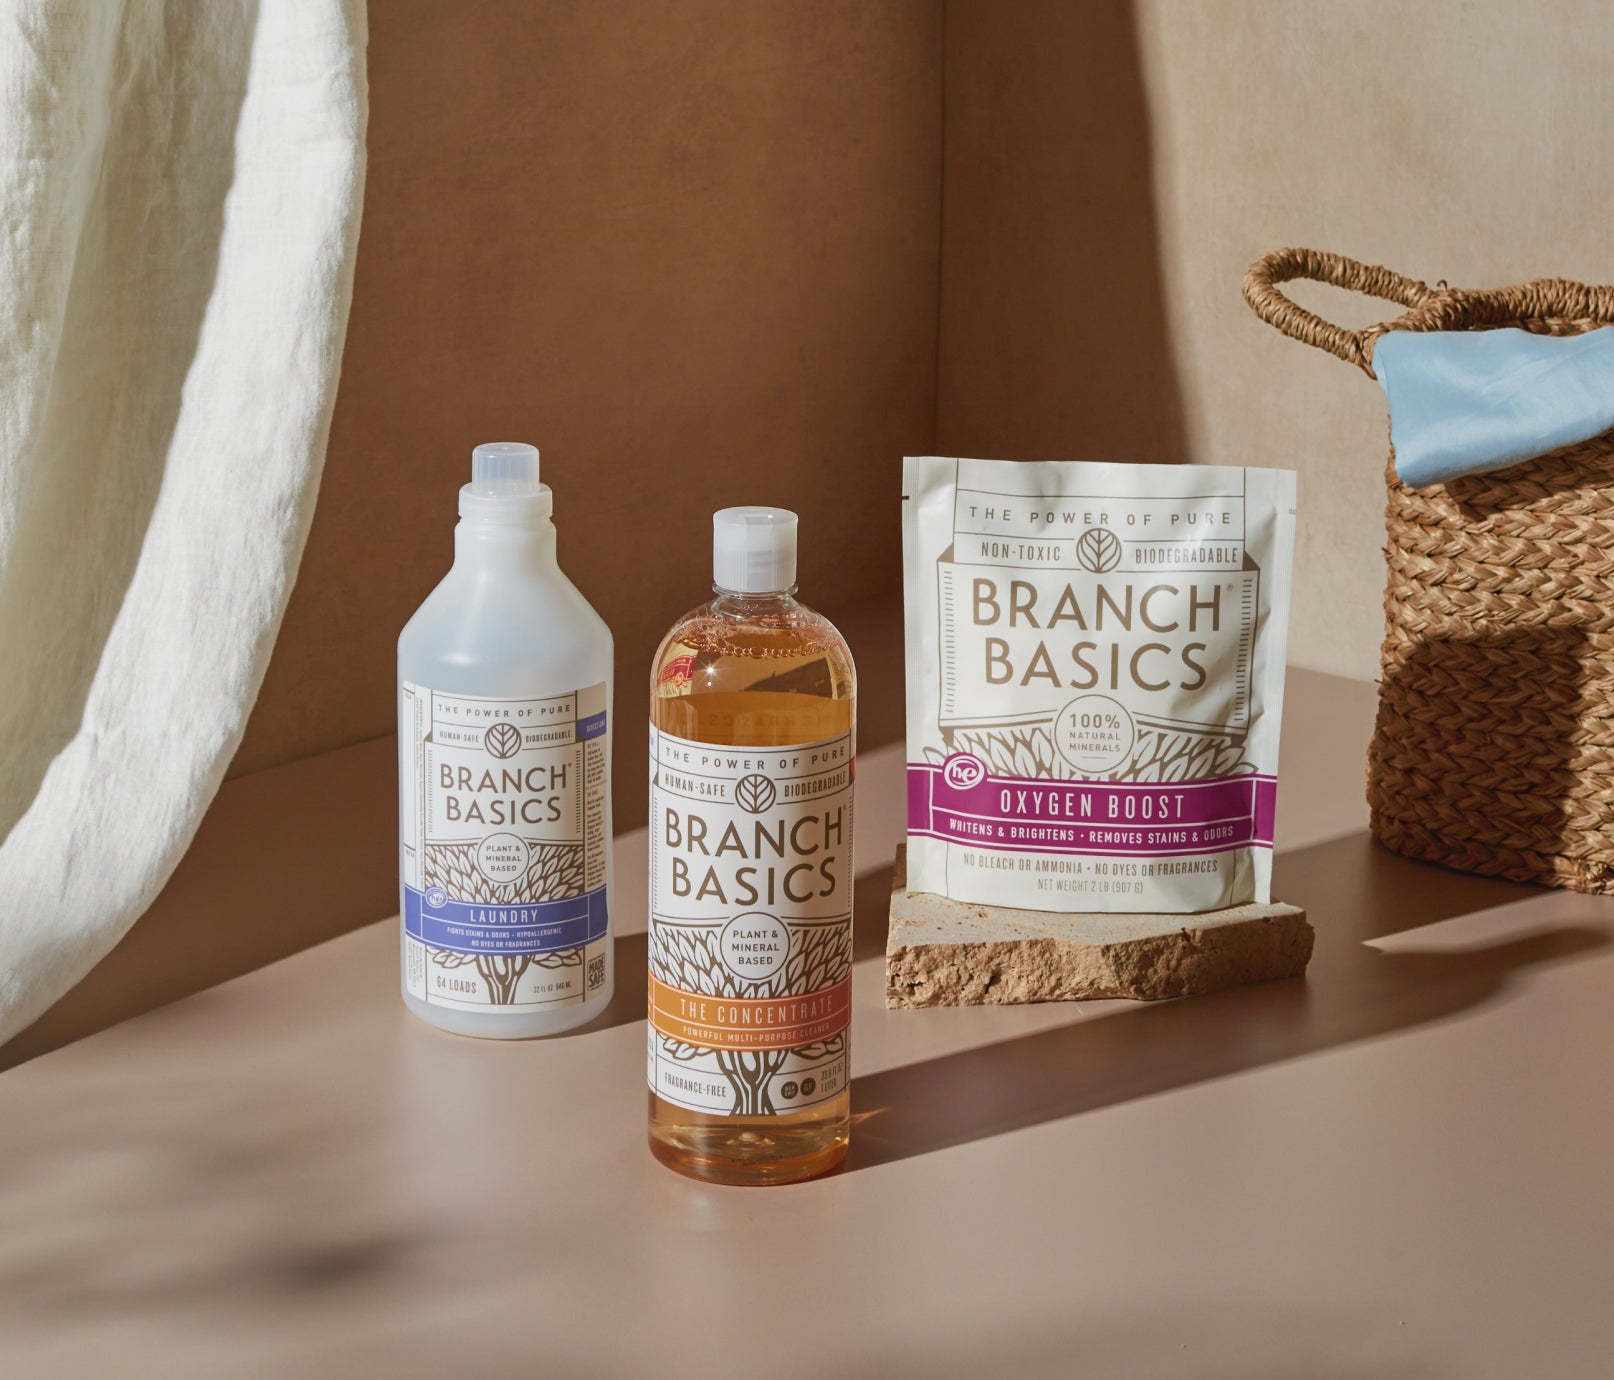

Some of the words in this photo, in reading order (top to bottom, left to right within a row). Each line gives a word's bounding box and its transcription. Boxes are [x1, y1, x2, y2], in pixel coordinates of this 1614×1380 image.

[969, 506, 1012, 522] THE
[1030, 512, 1109, 526] POWER
[1126, 514, 1152, 526] OF
[1171, 512, 1230, 526] PURE
[981, 542, 1061, 561] NON-TOXIC
[1135, 548, 1238, 564] BIODEGRADABLE
[972, 578, 1221, 632] BRANCH
[985, 637, 1207, 692] BASICS
[438, 704, 458, 714] THE
[466, 708, 510, 718] POWER
[541, 704, 571, 715] PURE
[1070, 713, 1120, 729] 100%
[440, 731, 479, 742] HUMAN-SAFE
[526, 730, 572, 742] BIODEGRADABLE
[1069, 732, 1121, 740] NATURAL
[1069, 743, 1121, 752] MINERALS
[666, 747, 689, 763] THE
[702, 756, 764, 770] POWER
[780, 758, 800, 768] OF
[812, 746, 844, 764] PURE
[440, 763, 567, 793] BRANCH
[665, 773, 726, 796] HUMAN-SAFE
[784, 770, 846, 797] BIODEGRADABLE
[446, 796, 561, 826] BASICS
[1000, 790, 1092, 817] OXYGEN
[1109, 795, 1184, 818] BOOST
[666, 807, 842, 859] BRANCH
[950, 818, 992, 836] WHITENS
[998, 827, 1005, 836] &
[1011, 828, 1074, 841] BRIGHTENS
[1089, 830, 1142, 844] REMOVES
[1148, 830, 1186, 843] STAINS
[1192, 832, 1199, 842] &
[1203, 826, 1234, 841] ODORS
[964, 853, 976, 866] NO
[979, 855, 1015, 870] BLEACH
[1019, 858, 1031, 871] OR
[1035, 860, 1082, 874] AMMONIA
[1095, 863, 1108, 875] NO
[1113, 863, 1137, 876] DYES
[1142, 862, 1154, 875] OR
[1157, 859, 1218, 876] FRAGRANCES
[672, 856, 836, 906] BASICS
[1038, 879, 1052, 890] NET
[1055, 879, 1088, 892] WEIGHT
[1091, 881, 1096, 892] 2
[1099, 881, 1109, 892] LB
[1112, 881, 1131, 893] (907
[1134, 881, 1143, 893] G)
[470, 909, 538, 924] LAUNDRY
[732, 930, 768, 938] PLANT
[772, 930, 778, 938] &
[732, 944, 780, 952] MINERAL
[738, 956, 773, 965] BASED
[437, 976, 446, 988] 64
[450, 979, 476, 994] LOADS
[680, 999, 707, 1020] THE
[718, 995, 833, 1024] CONCENTRATE
[682, 1026, 724, 1040] POWERFUL
[728, 1032, 797, 1042] MULTI-PURPOSE
[800, 1023, 830, 1038] CLEANER
[664, 1072, 726, 1098] FRAGRANCE-FREE
